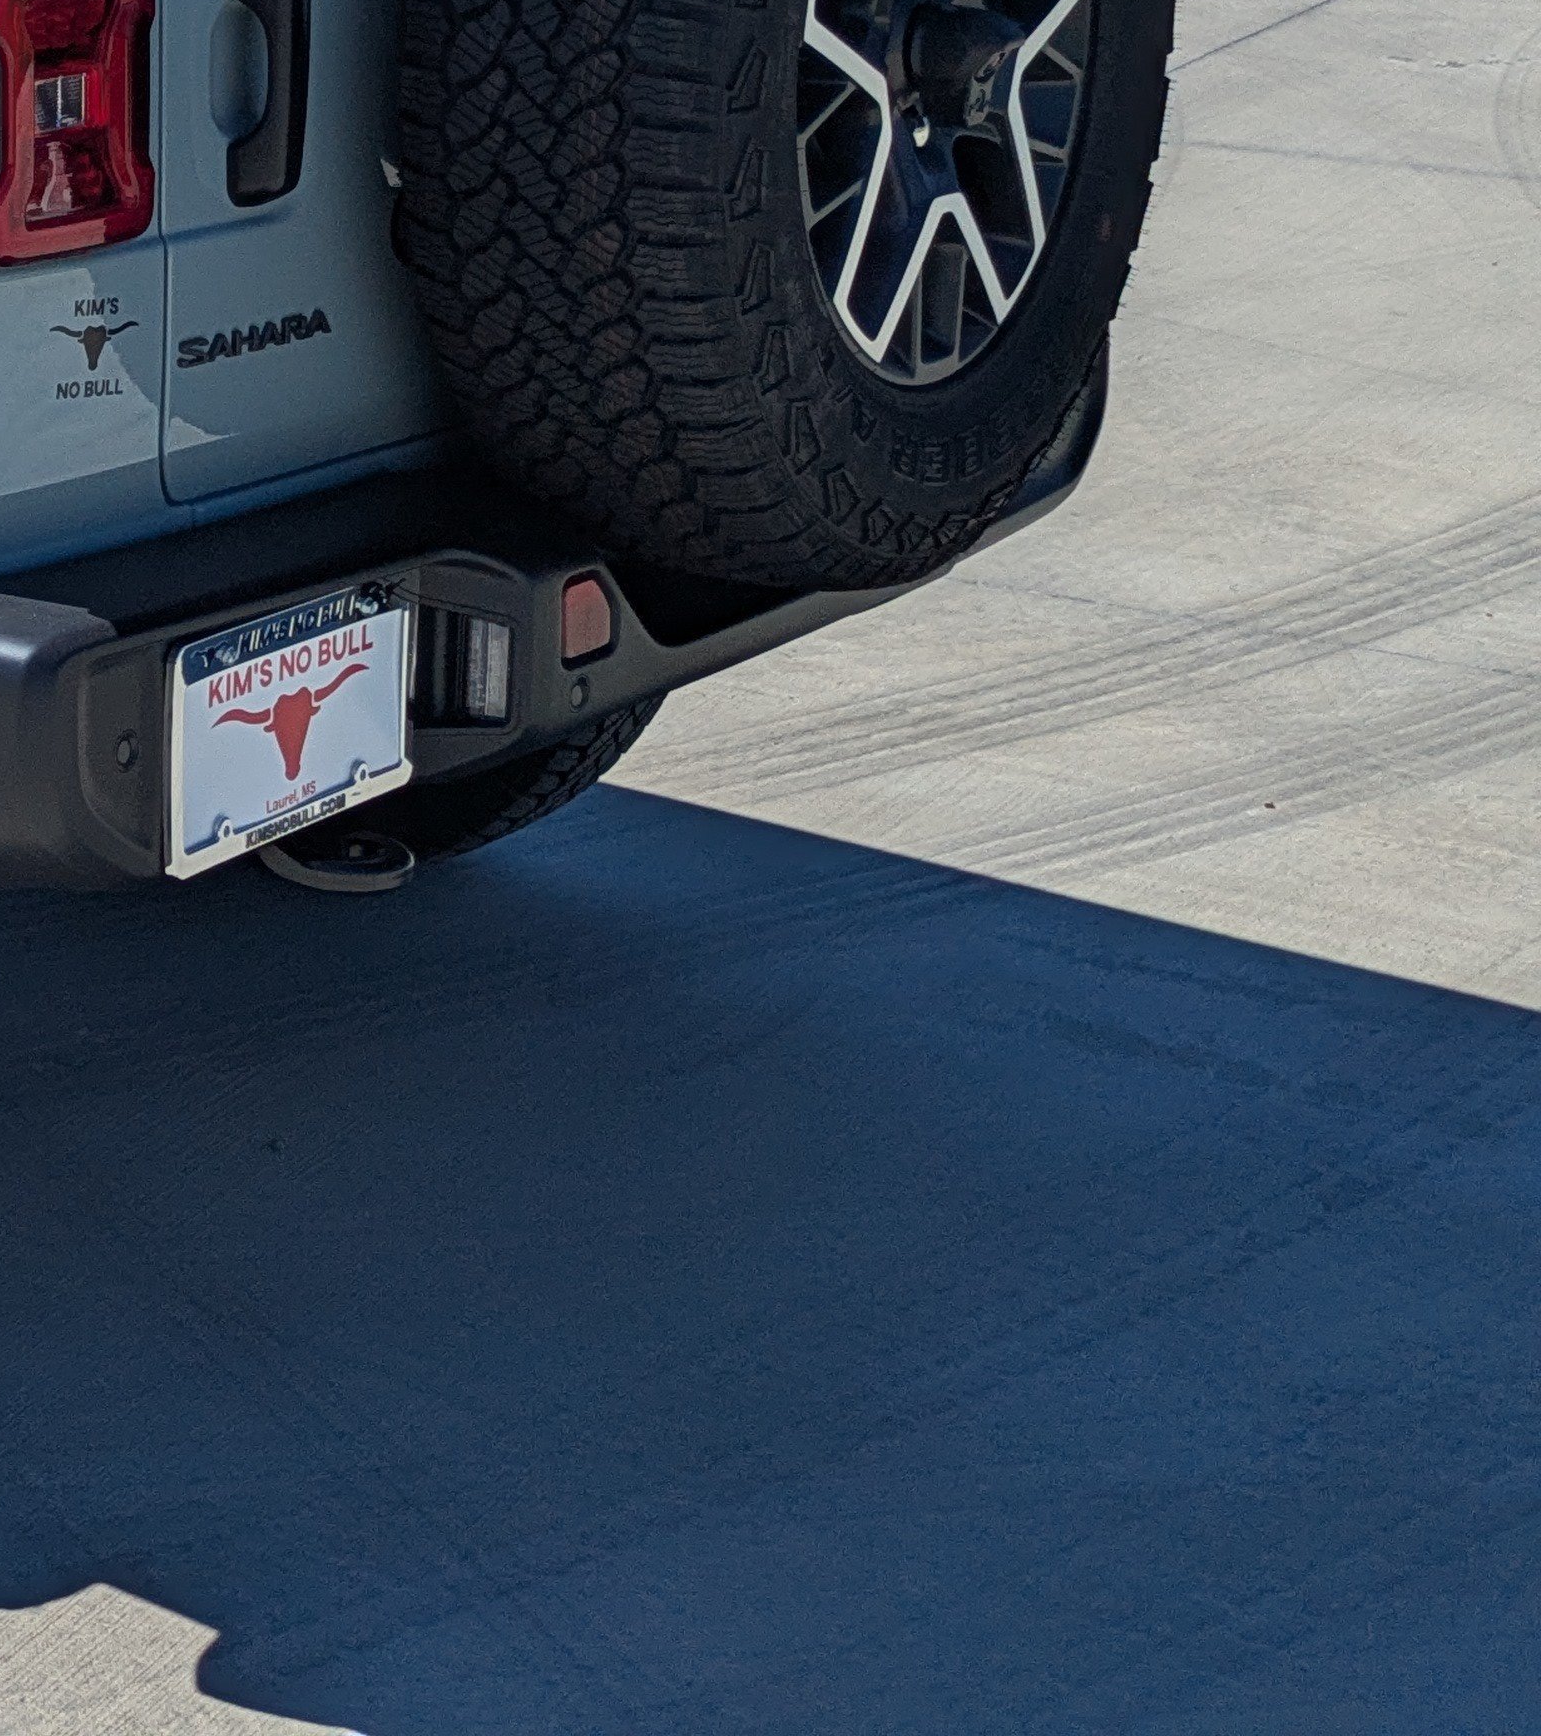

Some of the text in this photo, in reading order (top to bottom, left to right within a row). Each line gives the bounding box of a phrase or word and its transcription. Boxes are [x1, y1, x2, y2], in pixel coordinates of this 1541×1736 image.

[74, 297, 119, 317] KIM'S
[177, 308, 332, 368] SAHARA
[55, 379, 124, 400] NO BULL
[207, 624, 374, 709] KIM'S NO BULL
[245, 793, 347, 849] KIMSNOBULL.COM
[265, 788, 300, 814] Laurel,
